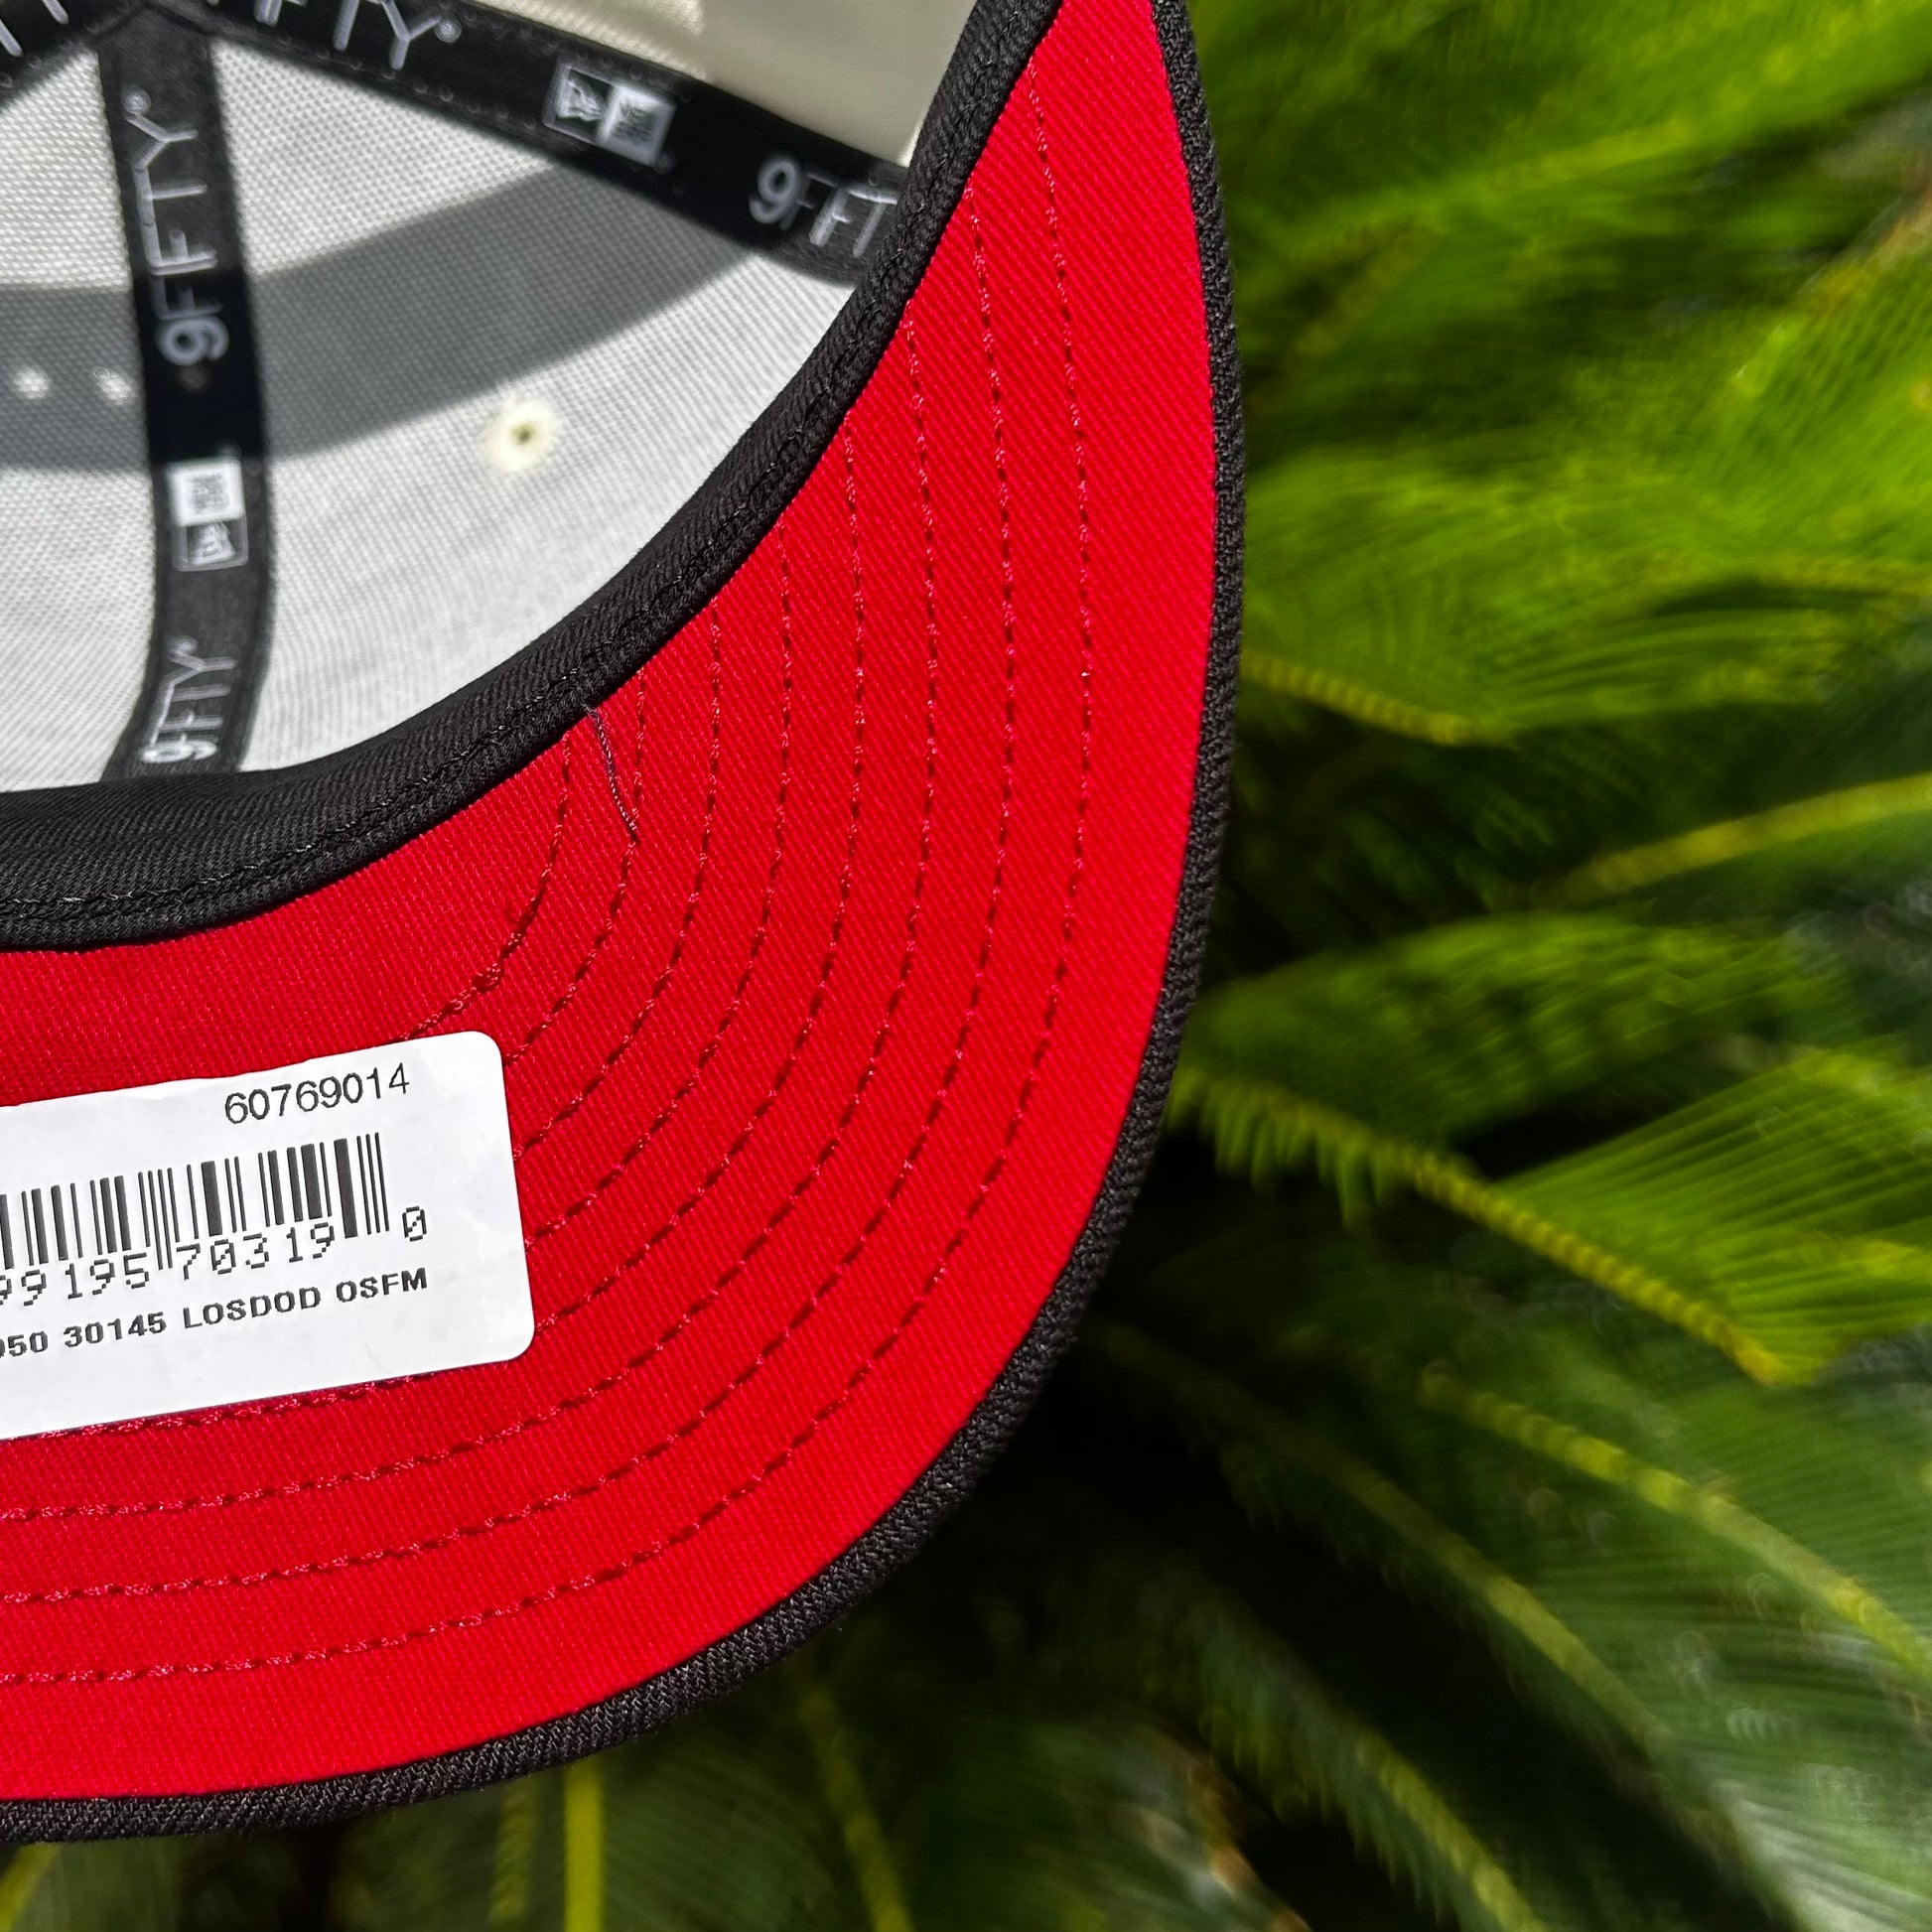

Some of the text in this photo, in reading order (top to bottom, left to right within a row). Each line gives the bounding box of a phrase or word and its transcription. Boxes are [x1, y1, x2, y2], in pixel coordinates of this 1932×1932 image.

[224, 1062, 410, 1125] 60769014
[176, 1221, 336, 1281] 70319
[401, 1205, 428, 1242] 0
[0, 1267, 429, 1359] 50 30145 LOSDOD OSFM
